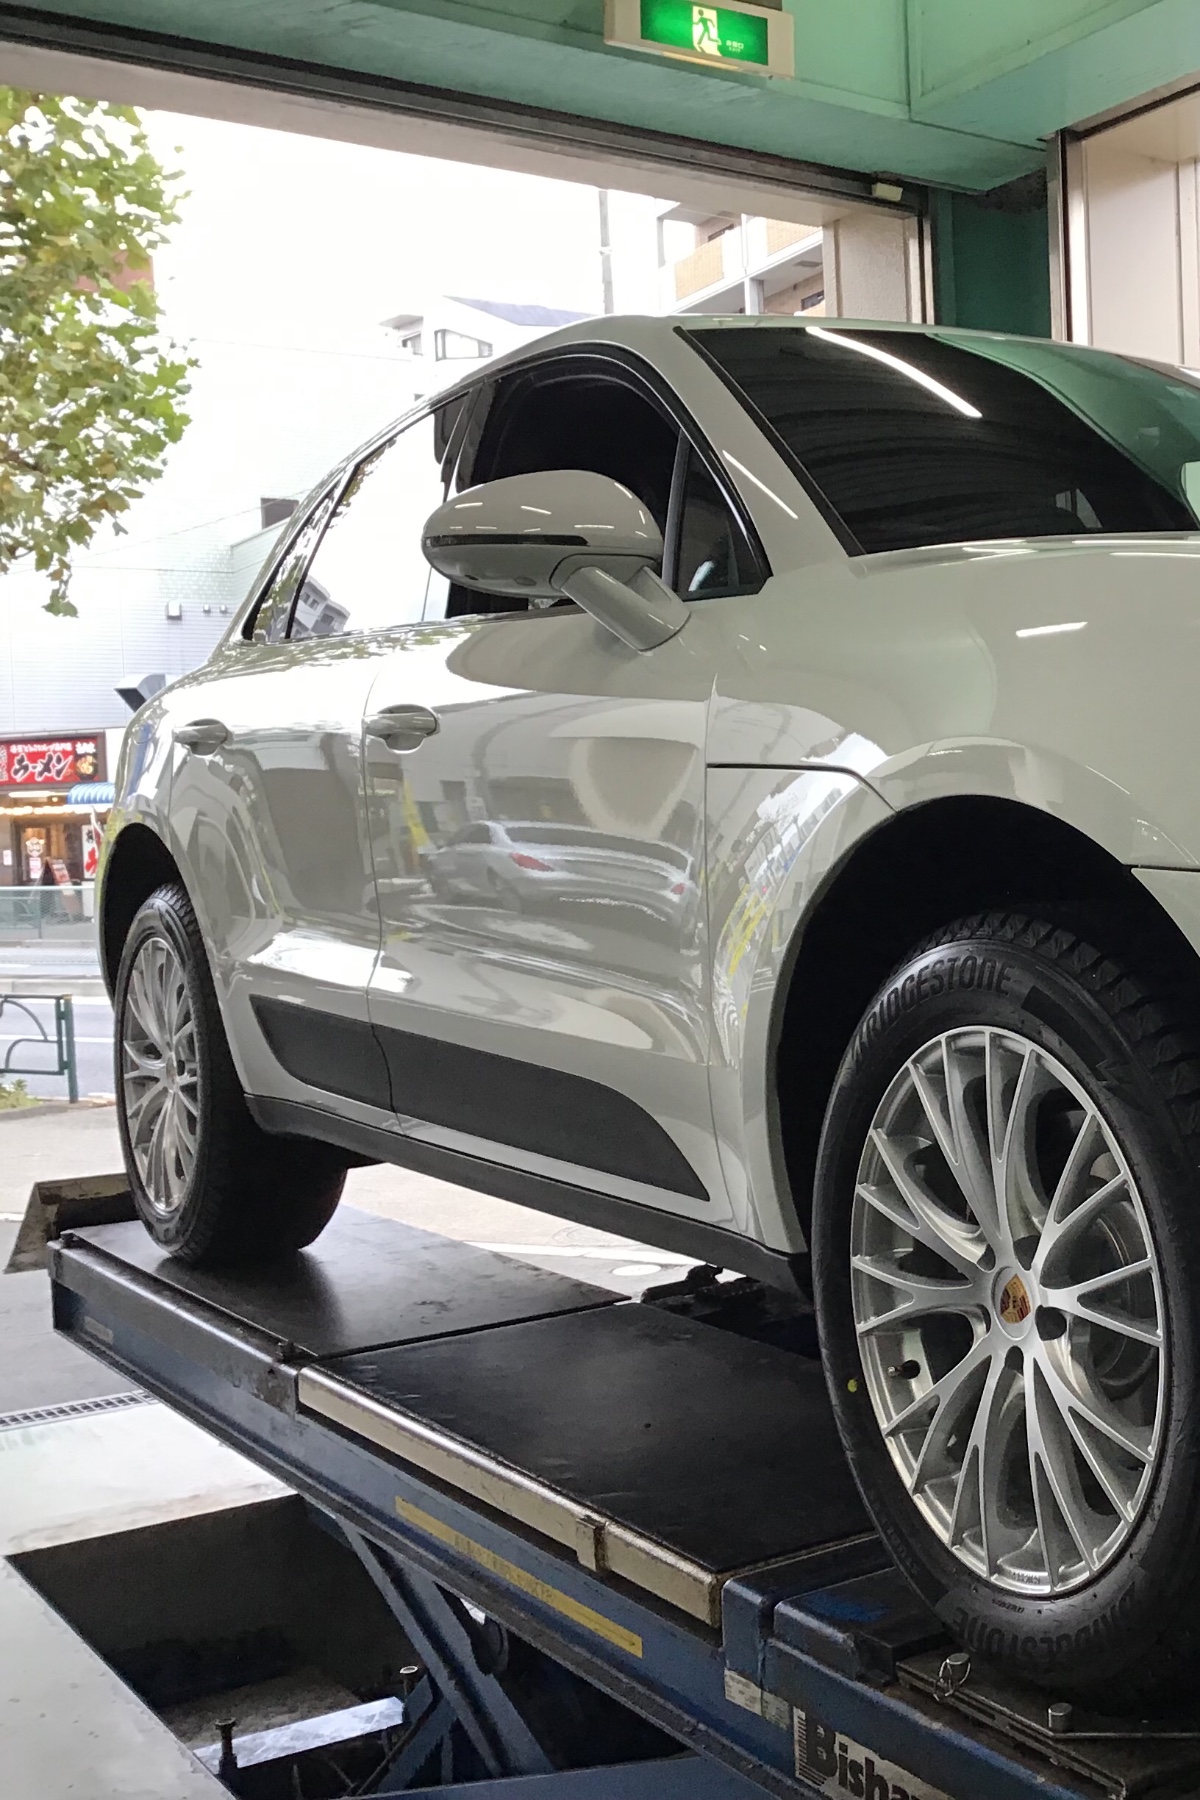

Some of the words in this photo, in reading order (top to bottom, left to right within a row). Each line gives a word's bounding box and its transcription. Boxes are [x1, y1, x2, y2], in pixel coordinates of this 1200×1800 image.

[11, 751, 74, 782] ラーメン
[852, 955, 1016, 1063] BRIDGESTONE
